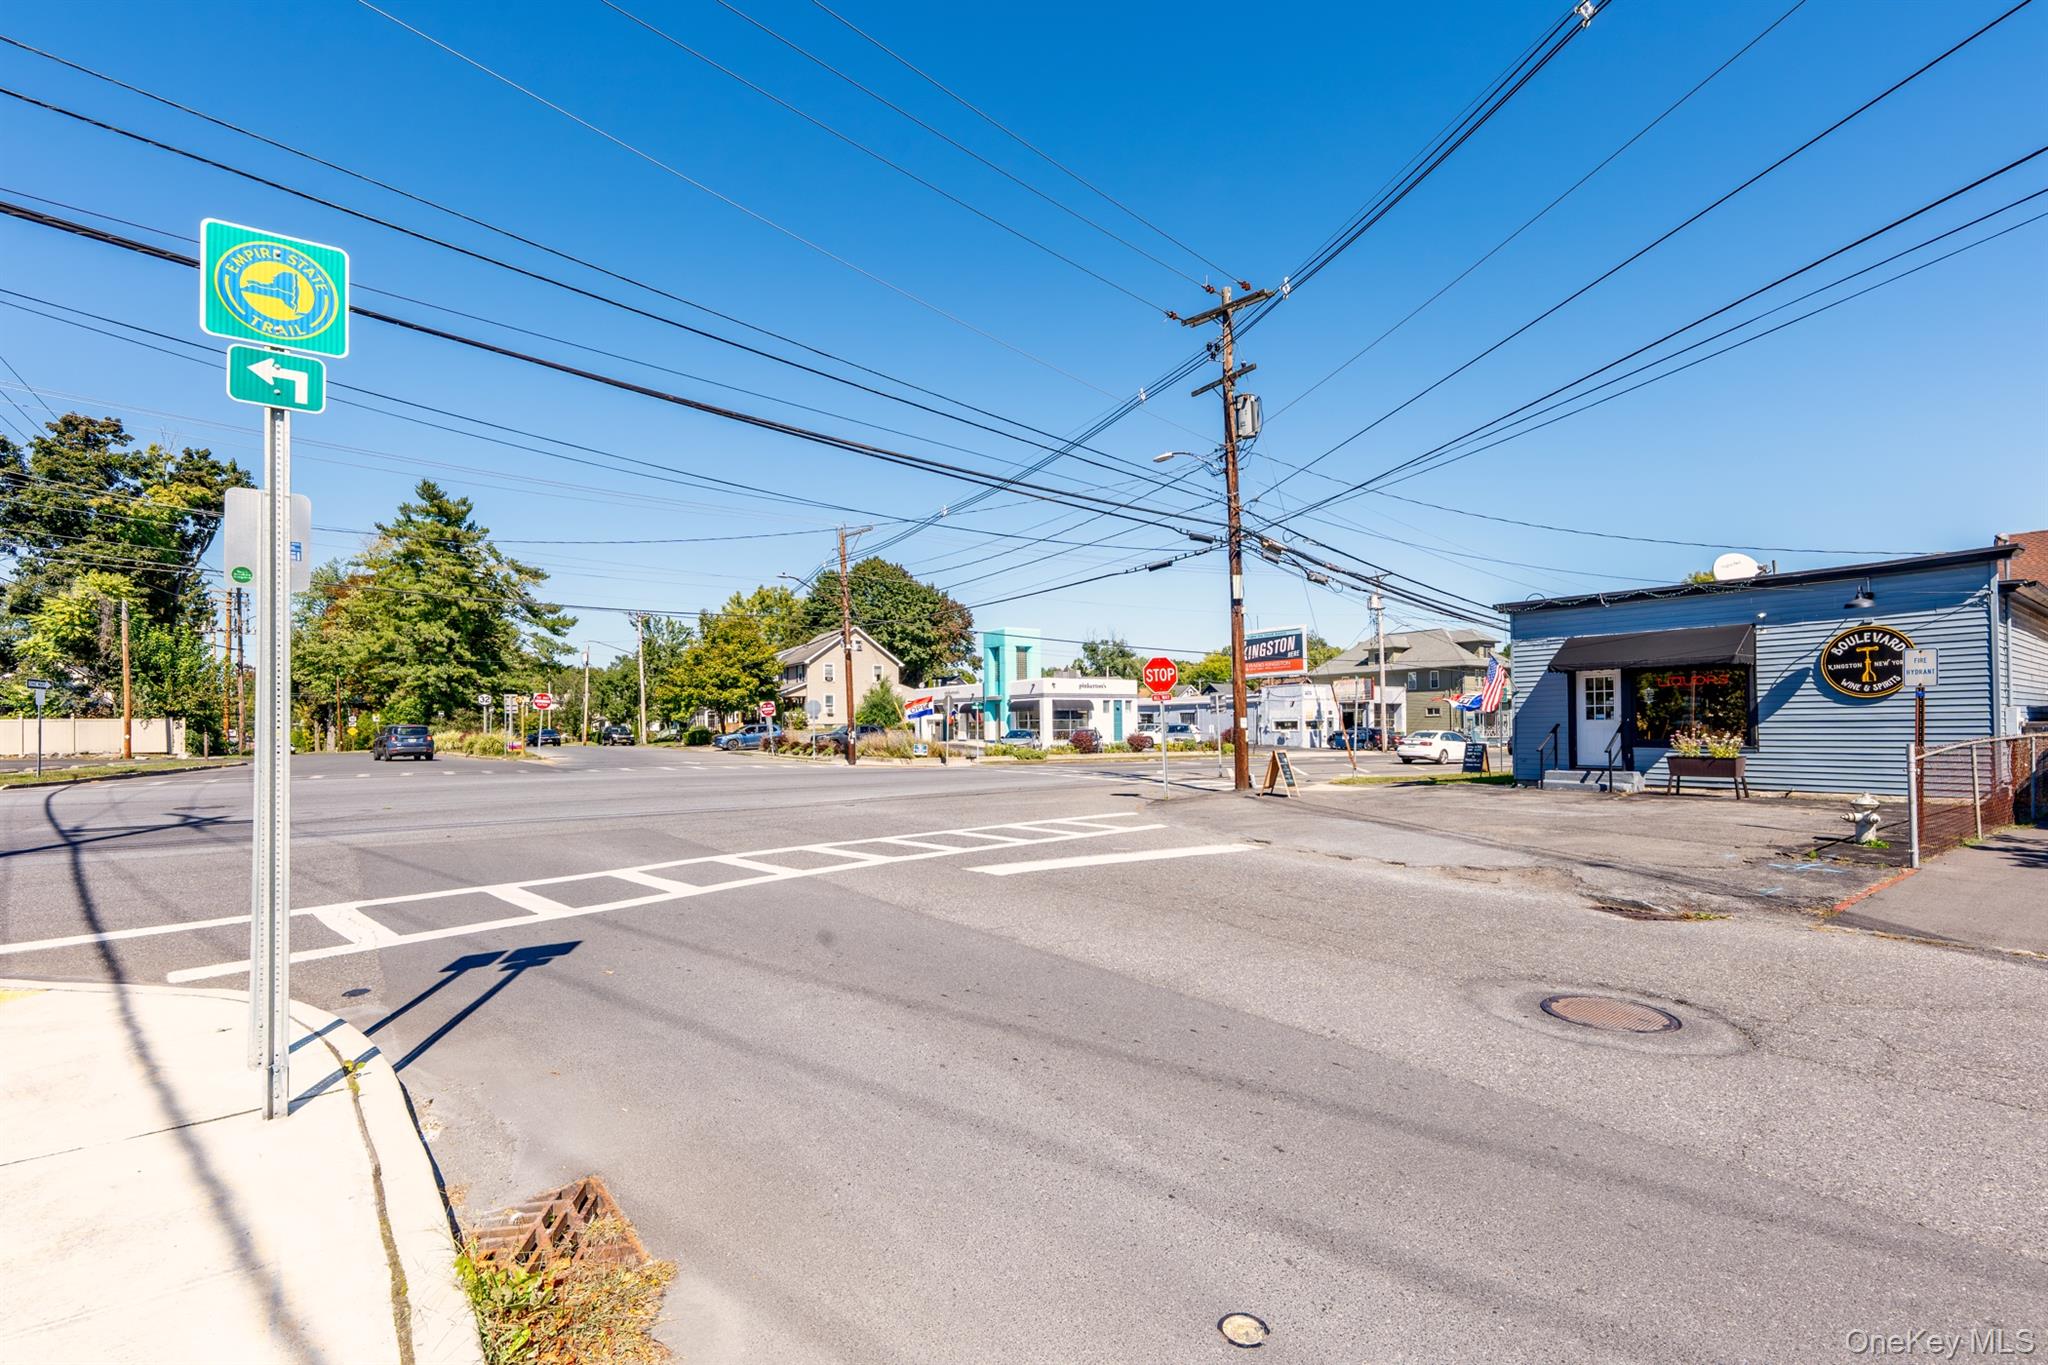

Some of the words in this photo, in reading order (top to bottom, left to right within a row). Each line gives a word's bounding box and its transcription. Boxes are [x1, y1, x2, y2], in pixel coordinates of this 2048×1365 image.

[225, 248, 281, 273] EMPIRE
[288, 254, 328, 291] STATE
[250, 315, 306, 336] TRAIL
[1244, 636, 1296, 660] KINGSTON
[1831, 632, 1906, 656] BOULEVARD
[1828, 662, 1862, 670] KINGSTON
[1146, 668, 1175, 682] STOP
[1656, 674, 1728, 687] LIQUORS
[1841, 679, 1861, 691] WINE
[1873, 675, 1901, 691] SPIRITS
[480, 695, 490, 703] 32
